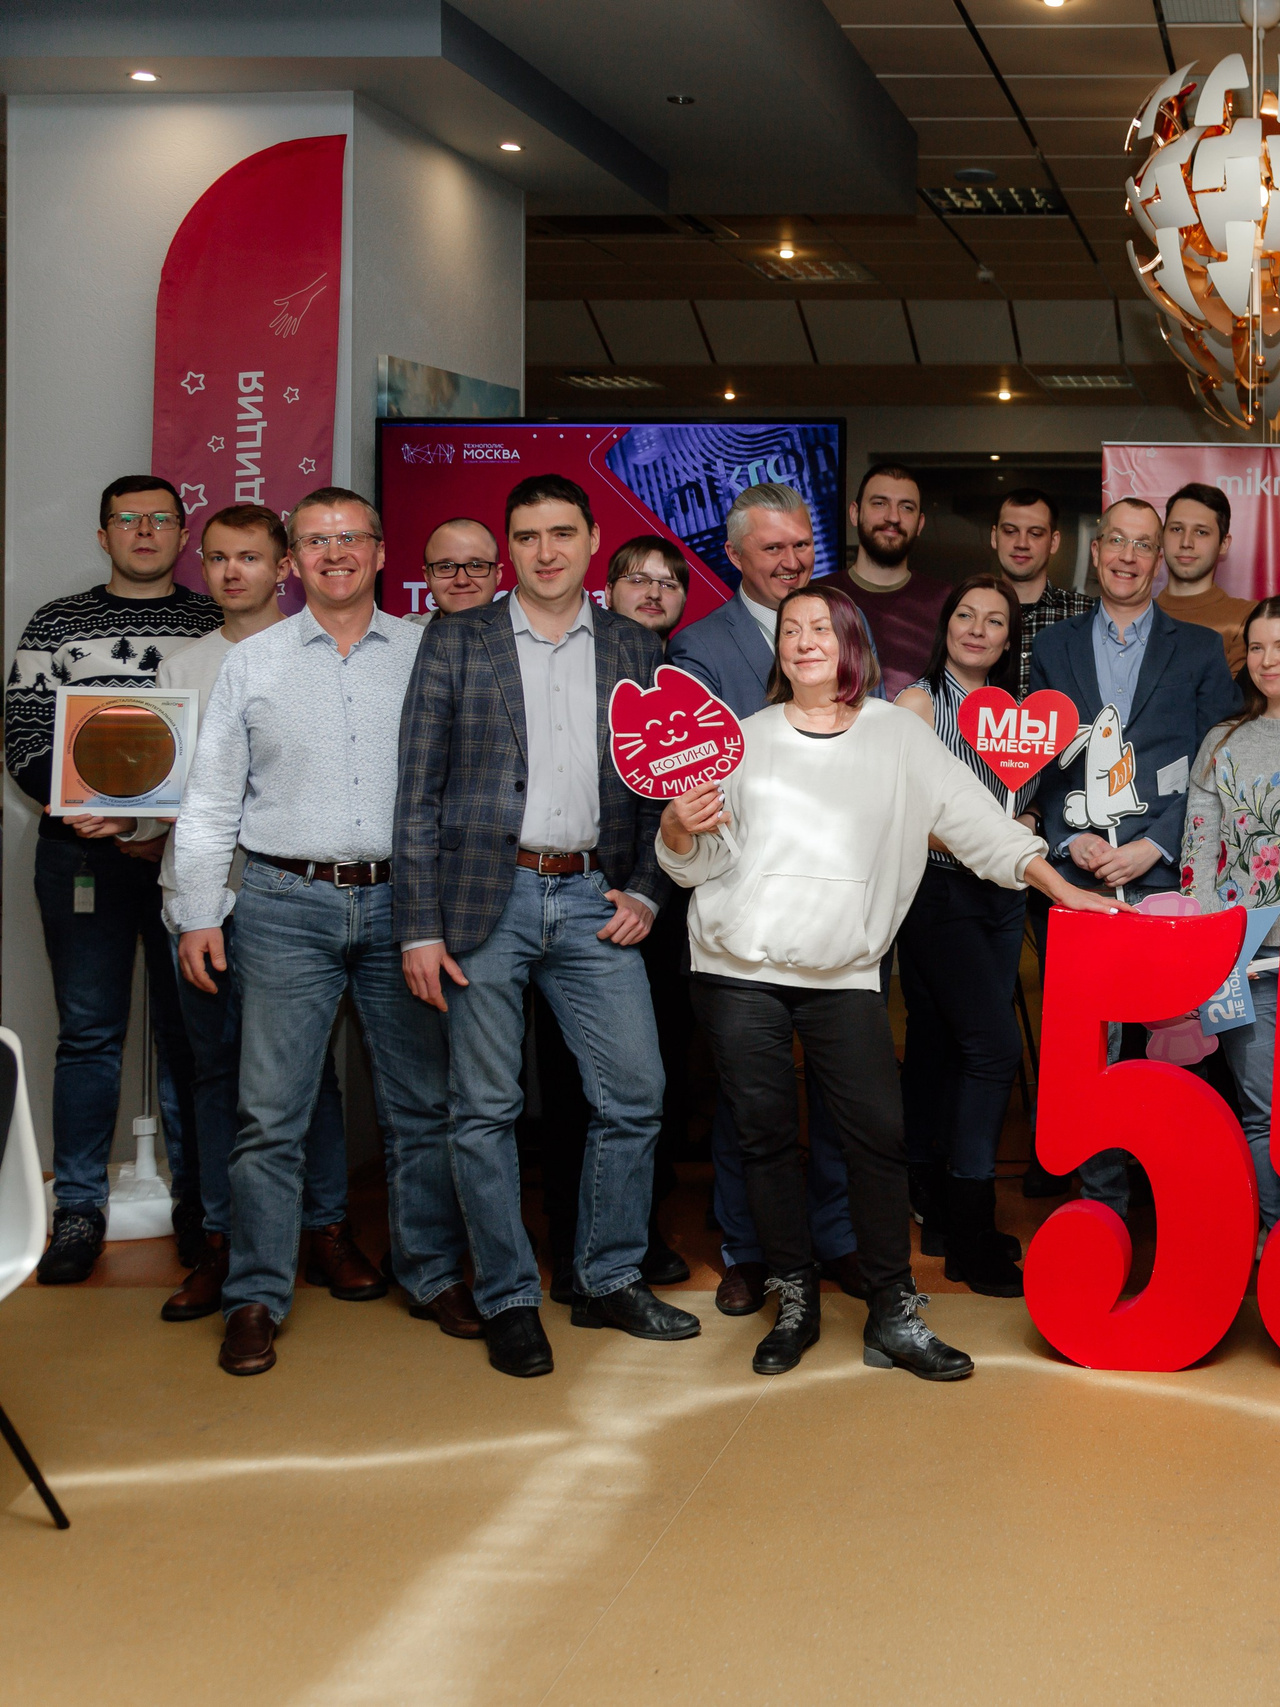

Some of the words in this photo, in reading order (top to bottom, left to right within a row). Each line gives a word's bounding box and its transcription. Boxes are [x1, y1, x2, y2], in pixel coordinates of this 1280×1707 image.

[463, 449, 521, 459] МОСКВА
[977, 706, 1059, 742] МЫ
[976, 737, 1056, 756] ВМЕСТЕ
[626, 768, 655, 794] НА
[662, 735, 742, 795] МИКРОНЕ
[652, 743, 716, 774] КОТИКИ
[1000, 760, 1030, 769] mikron
[1234, 999, 1247, 1018] НЕ
